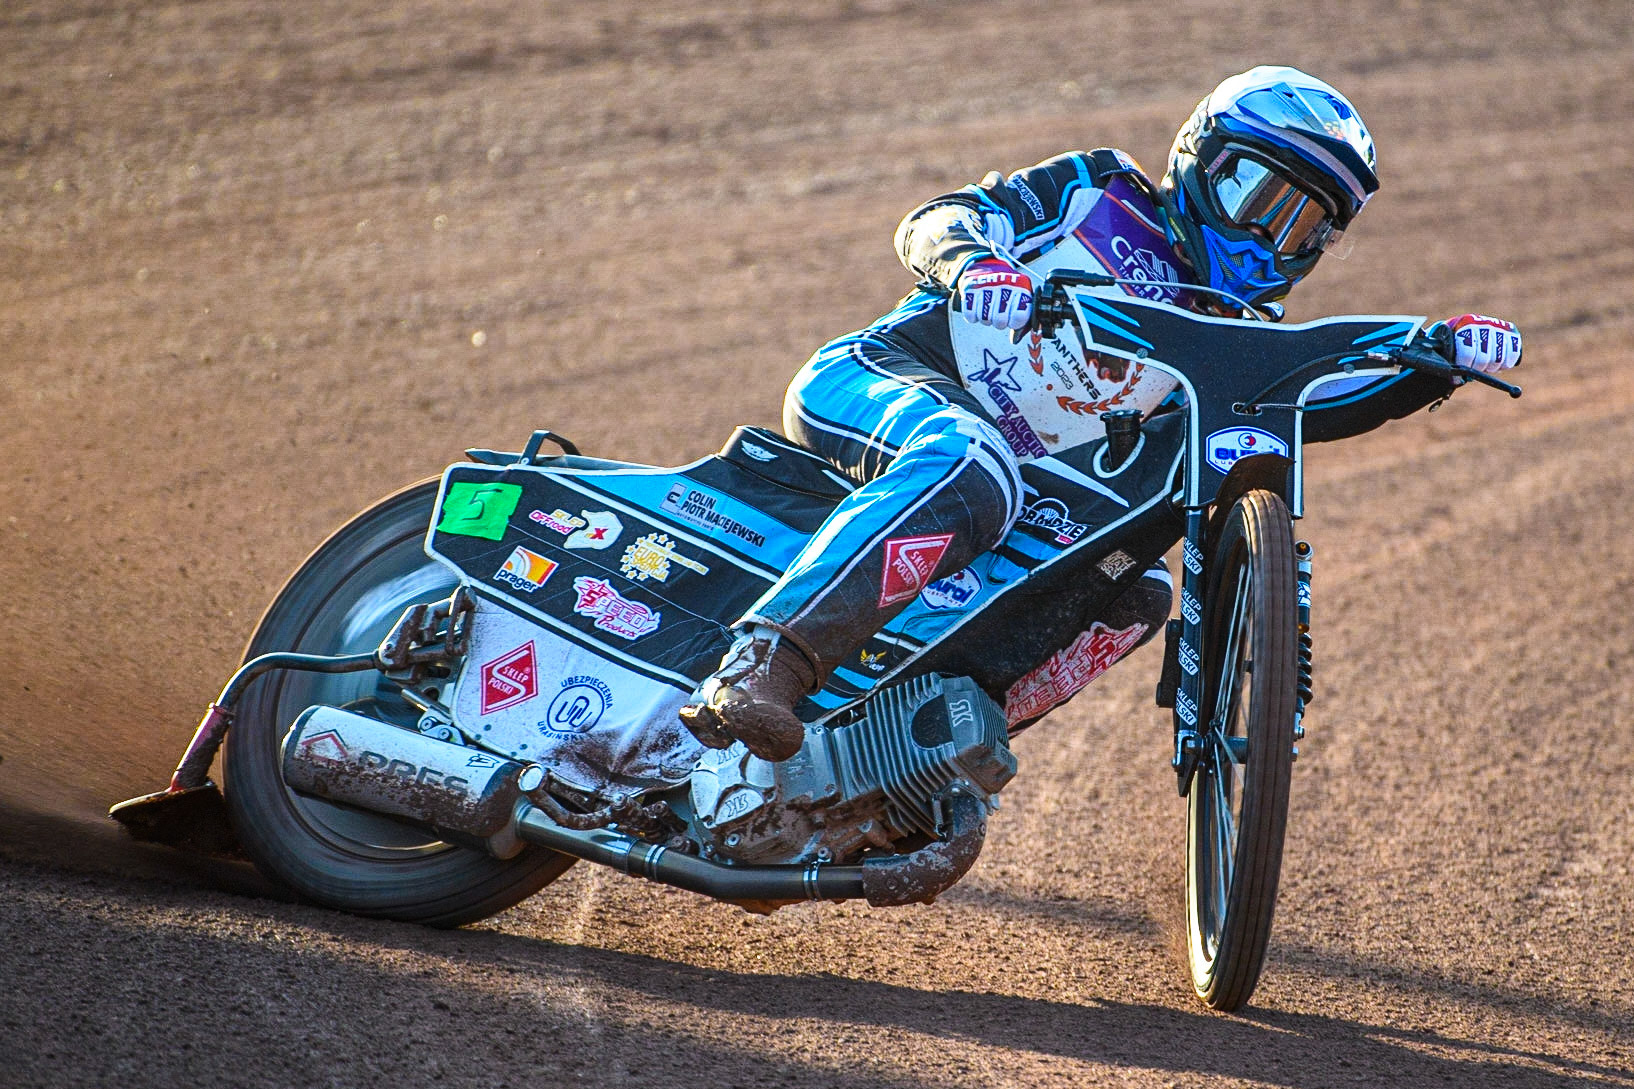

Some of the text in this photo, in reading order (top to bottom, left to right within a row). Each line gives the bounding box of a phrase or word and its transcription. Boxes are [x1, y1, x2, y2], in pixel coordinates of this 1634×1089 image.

[1111, 236, 1173, 304] Cren
[1050, 361, 1074, 390] 2023
[1051, 338, 1101, 400] ANTHERS
[989, 385, 1019, 417] CITY
[1011, 416, 1047, 458] AUCTIO
[997, 415, 1028, 457] GROUP
[462, 488, 503, 520] 5
[687, 490, 717, 510] COLIN
[680, 500, 766, 548] PIOTR MACIEJEWSKI
[633, 546, 665, 565] EURO
[496, 569, 537, 591] prager
[582, 588, 647, 630] SPEED
[487, 677, 514, 695] POLSKI
[502, 665, 529, 683] SKLEP
[560, 675, 614, 709] UBEZPIECZENIA
